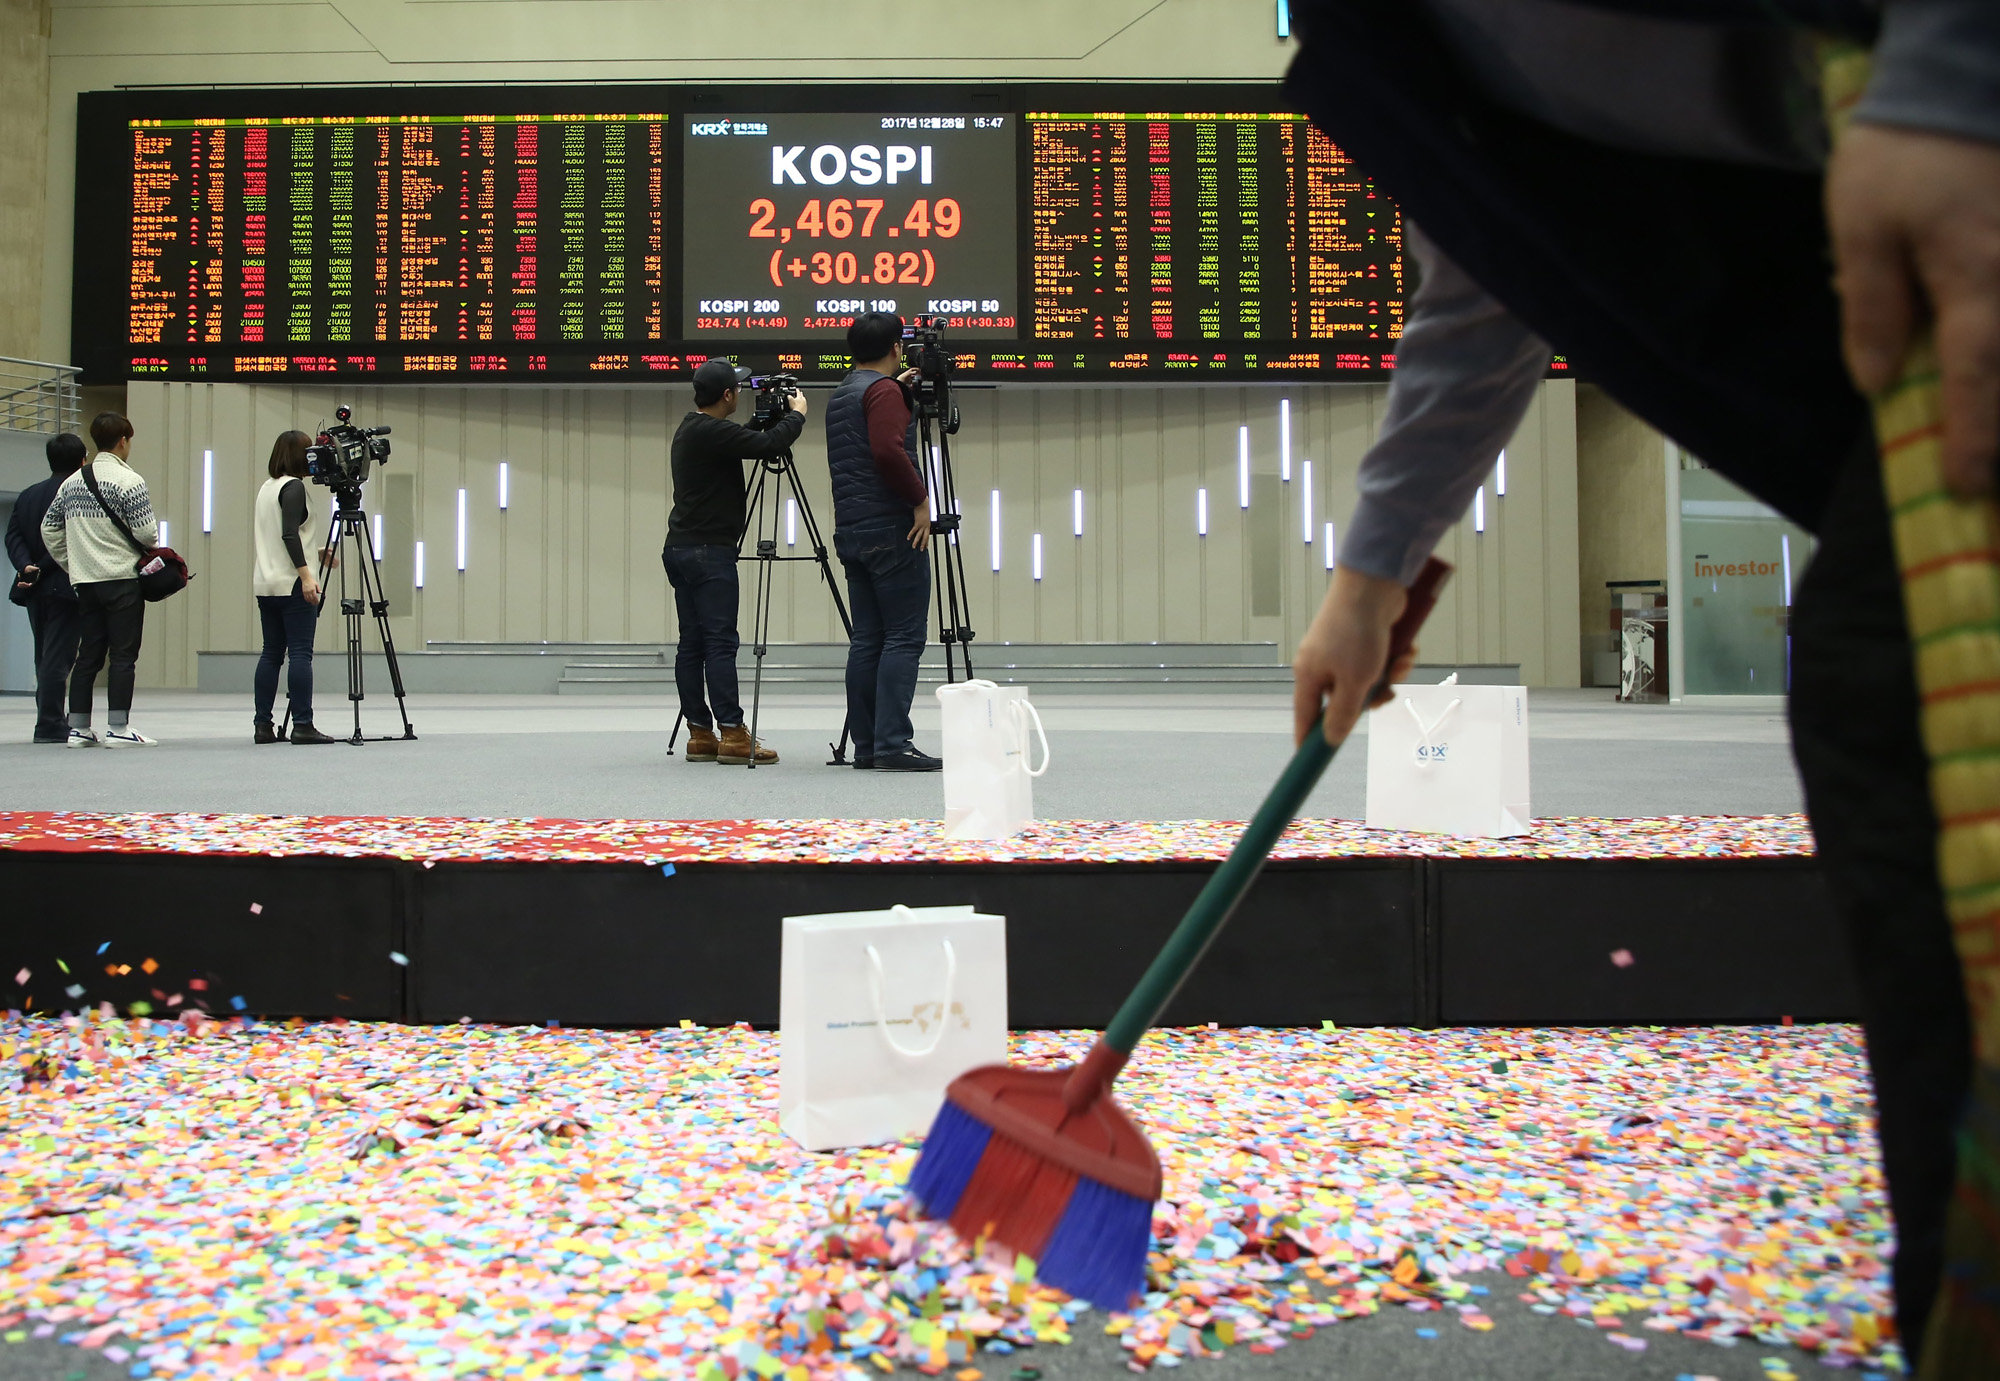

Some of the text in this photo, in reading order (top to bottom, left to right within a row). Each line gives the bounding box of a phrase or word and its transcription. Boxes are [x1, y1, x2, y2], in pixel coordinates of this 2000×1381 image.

[692, 118, 732, 135] KRX
[973, 117, 1004, 129] 15:47
[771, 145, 933, 185] KOSPI
[748, 197, 962, 244] 2,467.49
[132, 260, 154, 268] 오리온
[376, 258, 387, 266] 107
[206, 267, 222, 275] 6000
[329, 266, 351, 274] 107000
[568, 264, 583, 272] 5270
[768, 248, 936, 287] (+30.82)
[1390, 263, 1402, 271] 150
[700, 300, 780, 313] KOSPI 200
[816, 300, 897, 313] KOSPI 100
[928, 300, 1000, 313] KOSPI 50
[696, 317, 788, 329] 324.74 (+4.49)
[966, 316, 1016, 329] (+30.33)
[208, 327, 221, 335] 400
[331, 326, 350, 334] 35700
[561, 324, 583, 332] 104500
[1201, 323, 1219, 331] 13100
[1390, 323, 1405, 331] 250
[240, 335, 264, 343] 144000
[1387, 331, 1405, 339] 1200
[1695, 561, 1780, 577] Investor
